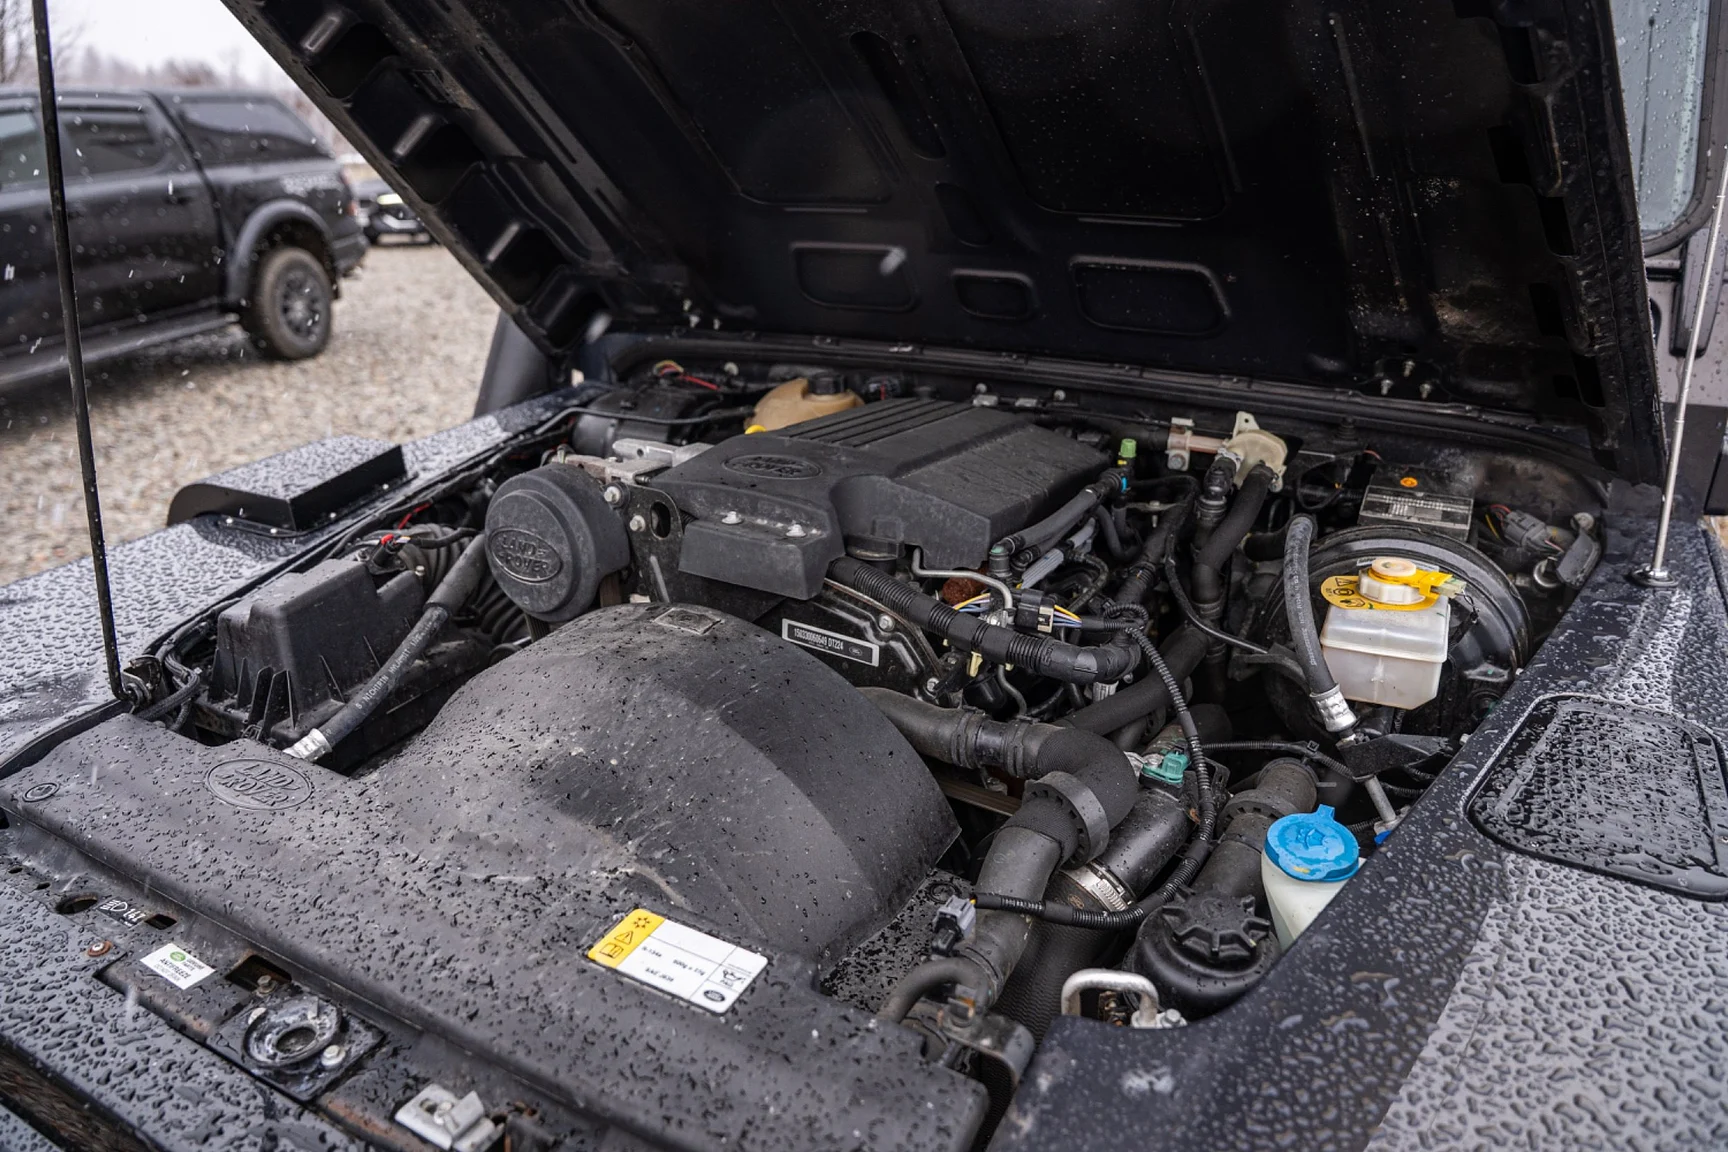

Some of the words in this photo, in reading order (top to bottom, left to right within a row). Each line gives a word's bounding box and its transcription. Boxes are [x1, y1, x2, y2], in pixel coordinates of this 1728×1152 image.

[500, 534, 539, 557] LAND
[505, 552, 550, 575] ROVER
[234, 764, 296, 788] LAND
[219, 778, 290, 806] ROVER
